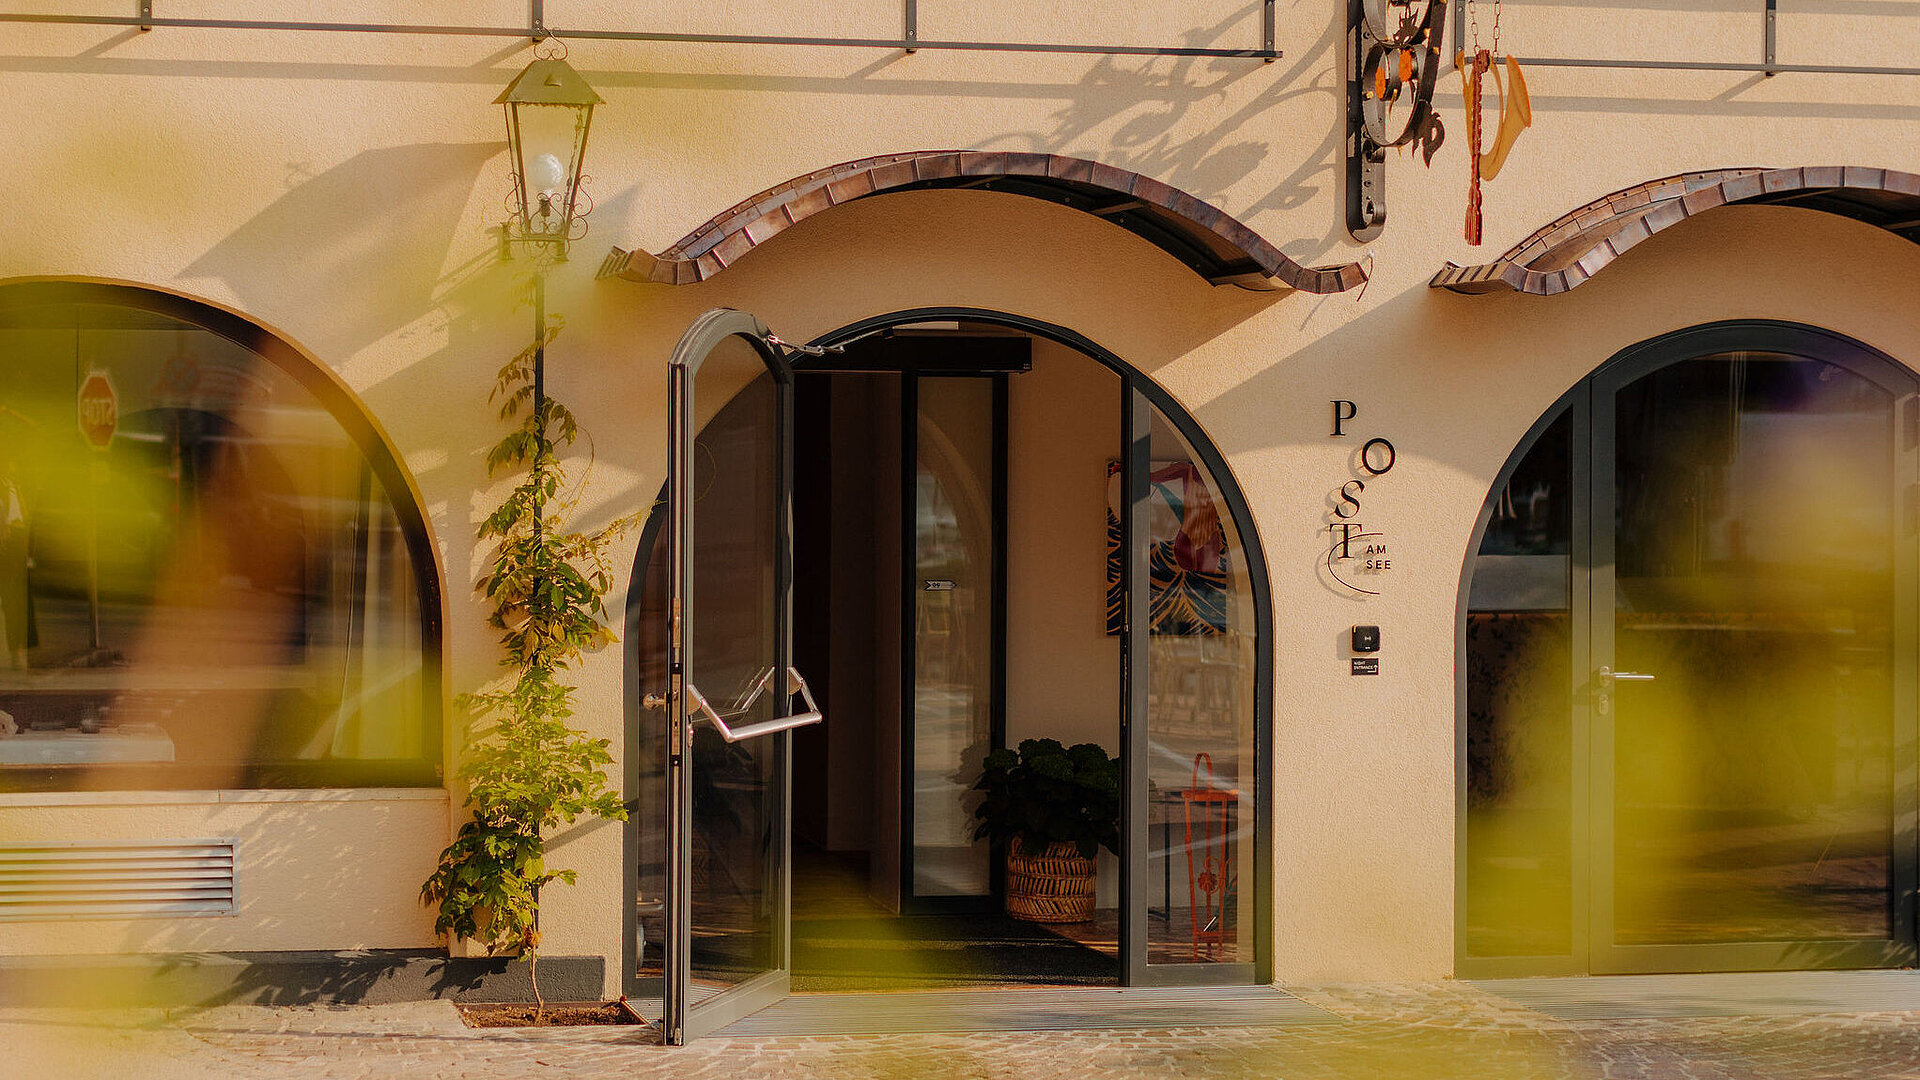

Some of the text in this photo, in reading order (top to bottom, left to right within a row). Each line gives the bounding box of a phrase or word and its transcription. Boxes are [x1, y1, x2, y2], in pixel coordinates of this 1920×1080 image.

[1329, 400, 1396, 559] POST
[1366, 544, 1386, 554] AM
[1366, 560, 1391, 569] SEE
